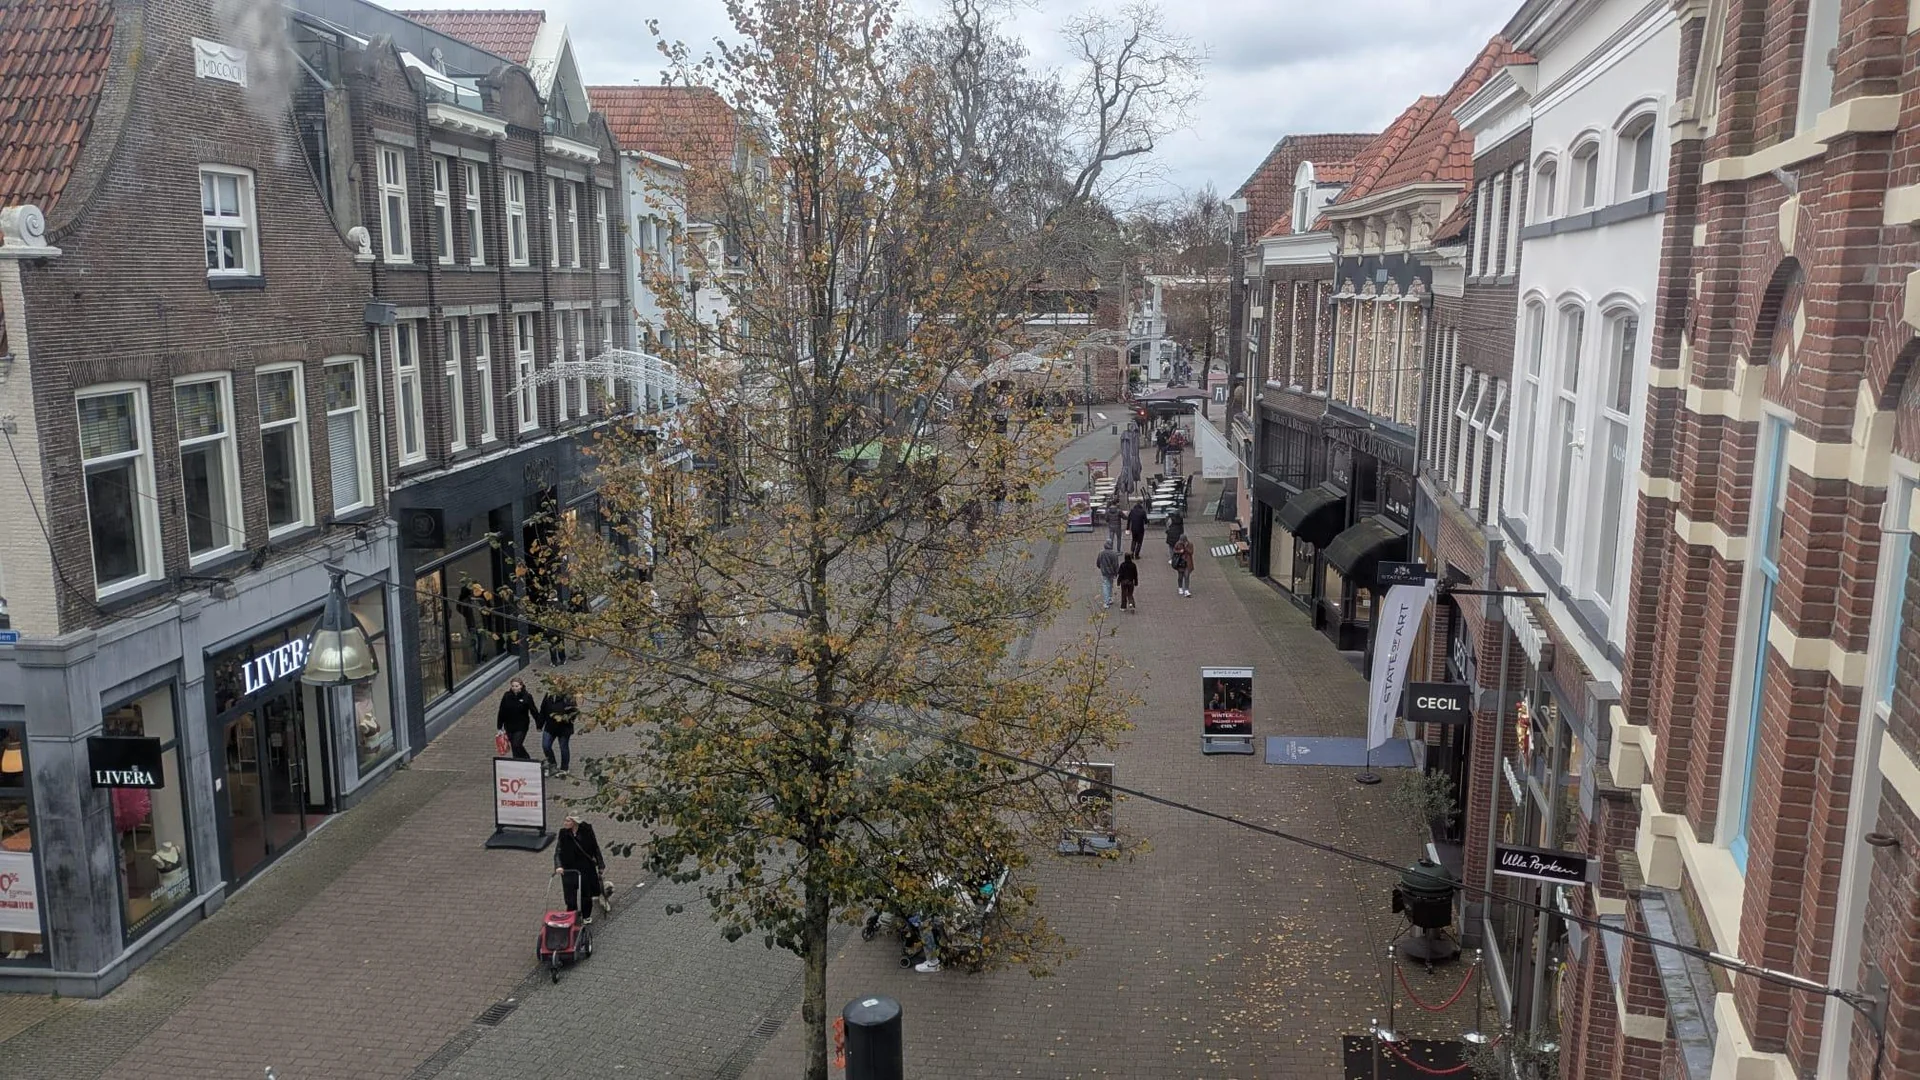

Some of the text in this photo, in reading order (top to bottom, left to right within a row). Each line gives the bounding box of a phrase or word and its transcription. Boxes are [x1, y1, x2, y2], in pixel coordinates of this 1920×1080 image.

[1360, 431, 1369, 452] &
[1369, 434, 1402, 466] DERKSEN
[1384, 652, 1398, 704] STATE
[1396, 603, 1409, 637] ART
[1416, 696, 1461, 711] CECIL
[95, 770, 155, 785] LIVERA
[1502, 851, 1579, 874] Ulla Popken
